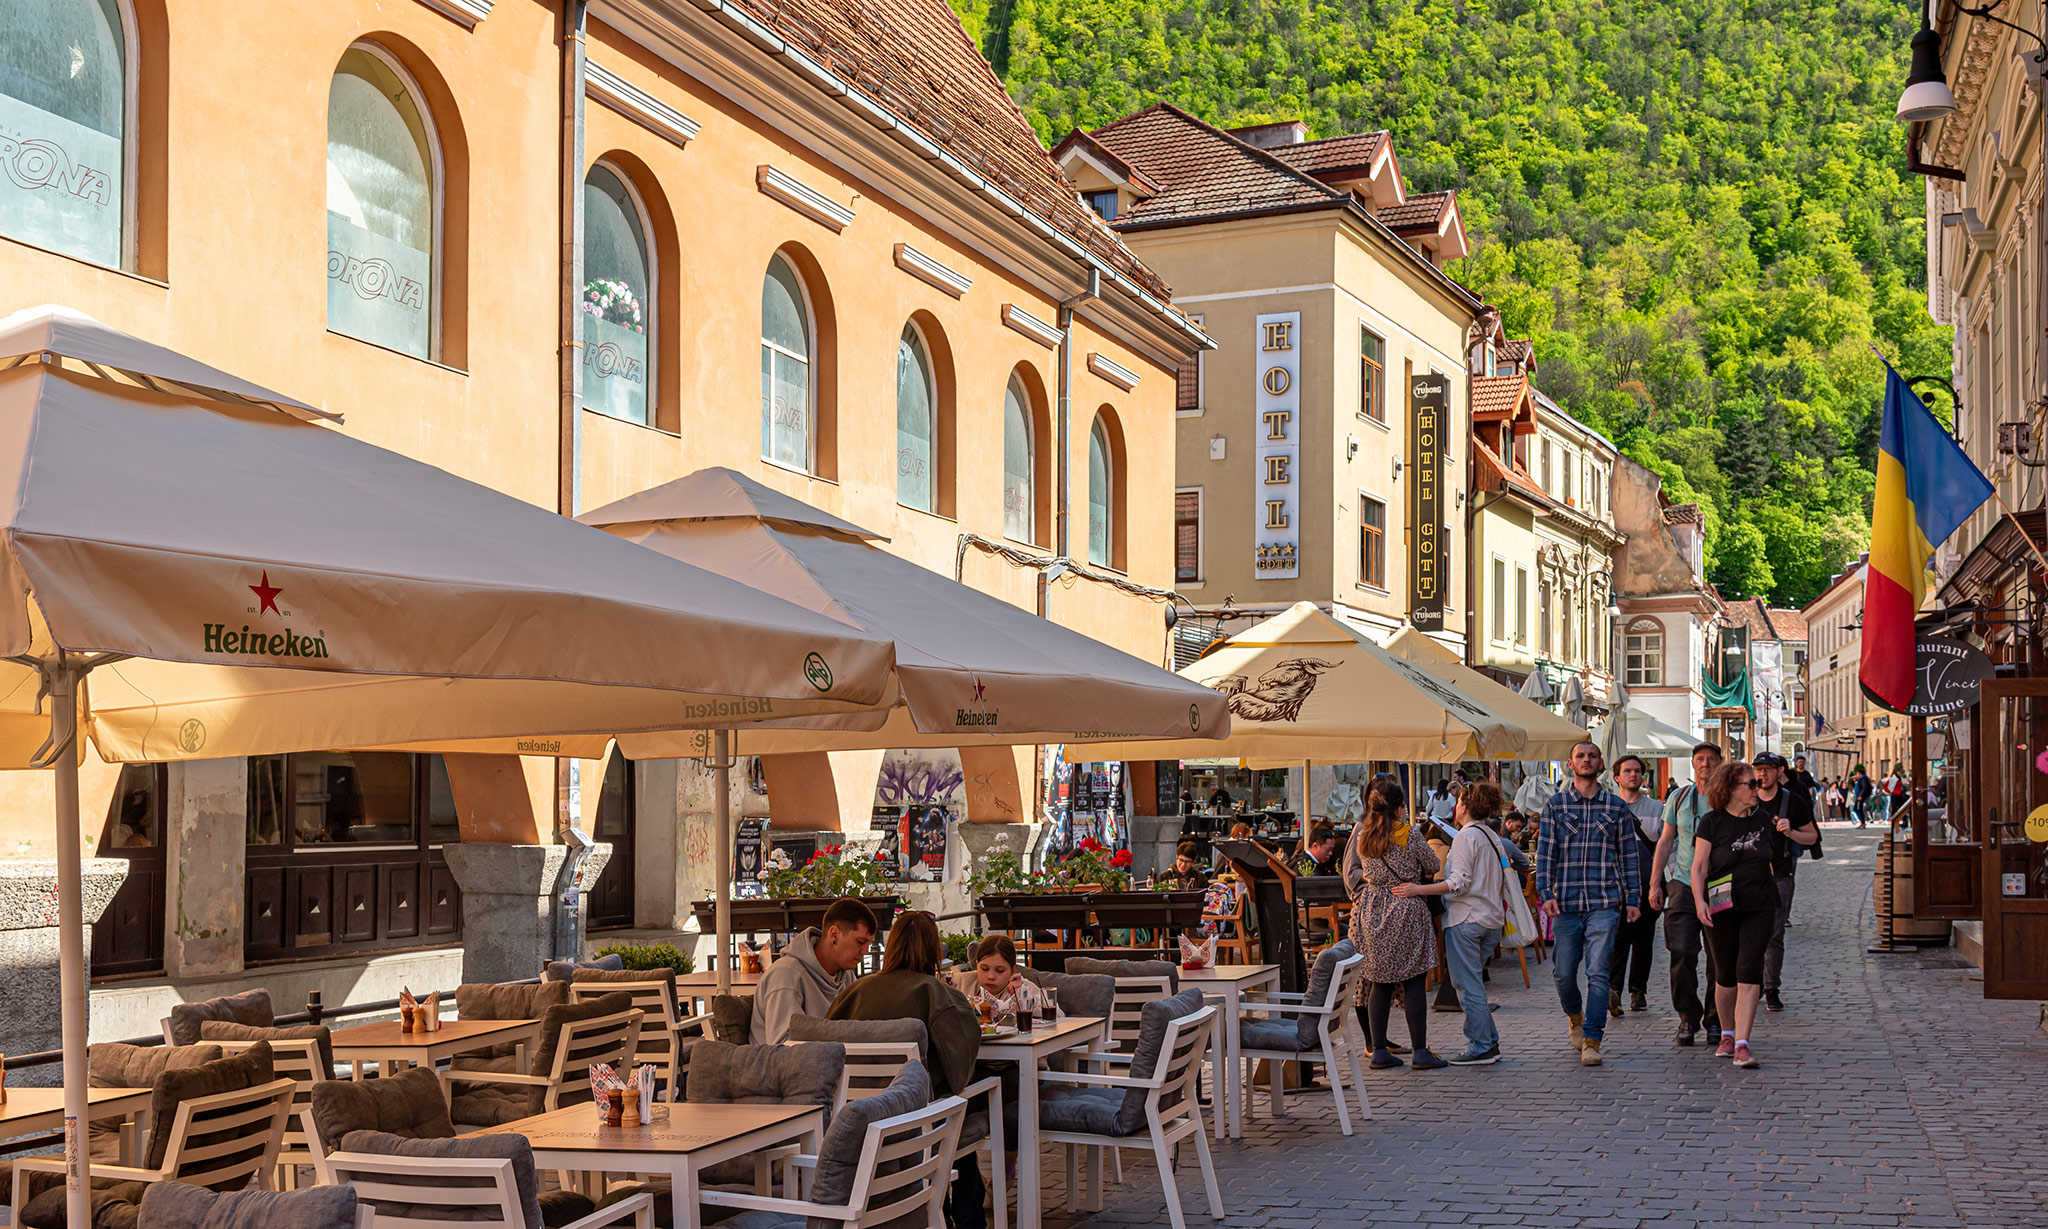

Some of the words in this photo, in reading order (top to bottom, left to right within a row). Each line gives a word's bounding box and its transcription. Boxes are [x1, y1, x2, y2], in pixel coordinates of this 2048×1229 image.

[583, 340, 643, 385] RONA
[1263, 321, 1292, 529] HOTEL
[1421, 416, 1434, 500] HOTEL
[203, 623, 329, 659] Heineken
[1917, 643, 1969, 659] aurant
[1908, 699, 1965, 714] nsiune
